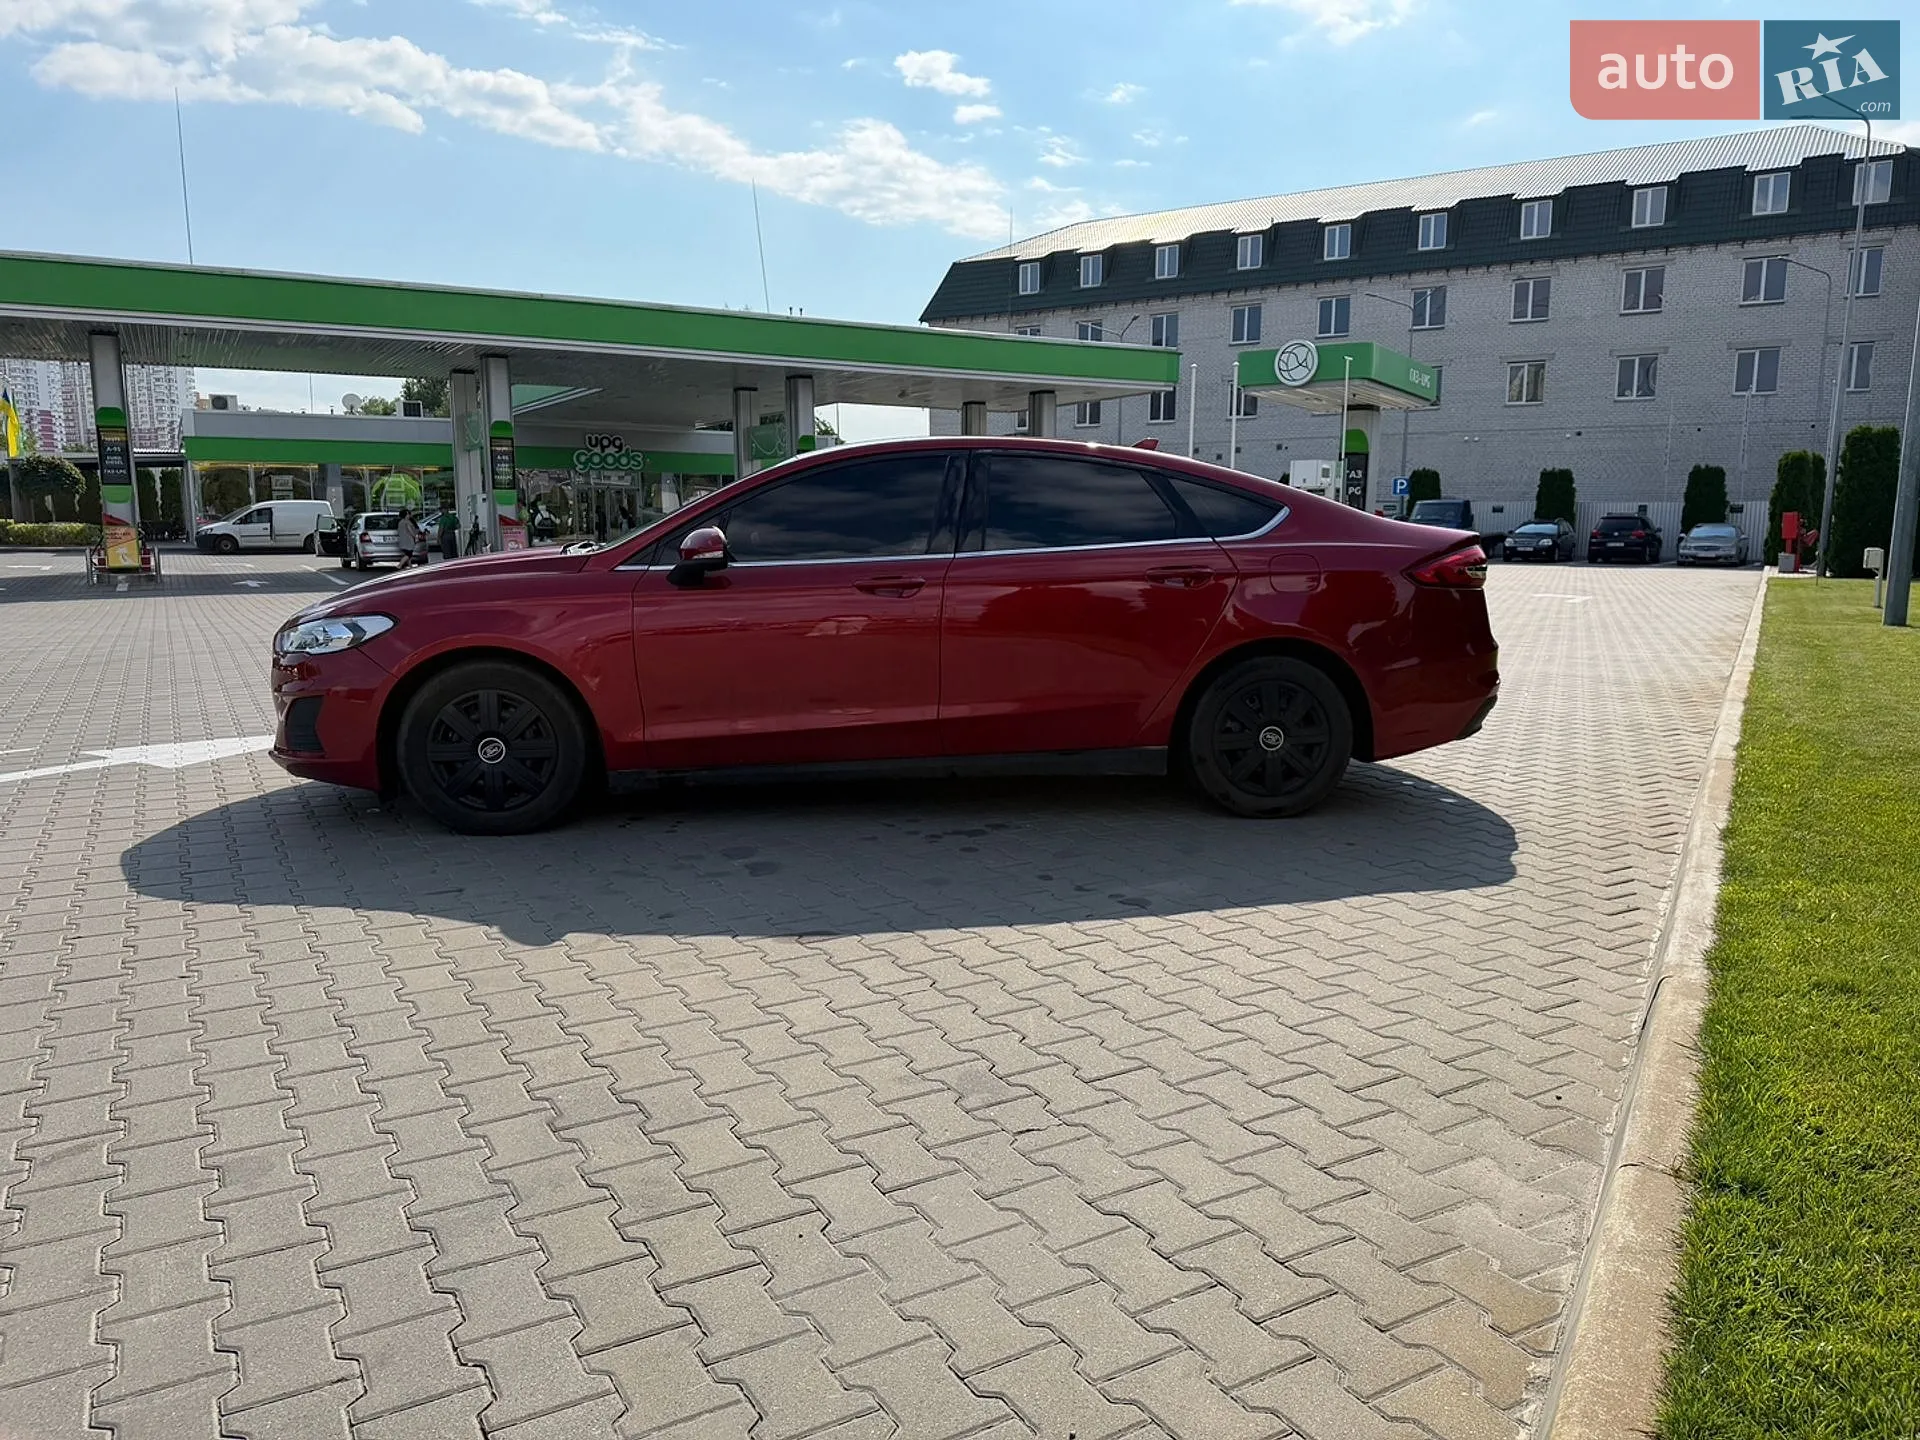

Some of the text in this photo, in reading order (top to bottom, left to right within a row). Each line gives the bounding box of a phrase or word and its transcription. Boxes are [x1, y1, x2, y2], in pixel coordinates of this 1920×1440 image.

[586, 434, 625, 454] upg
[573, 446, 644, 472] goods
[1397, 479, 1408, 495] P
